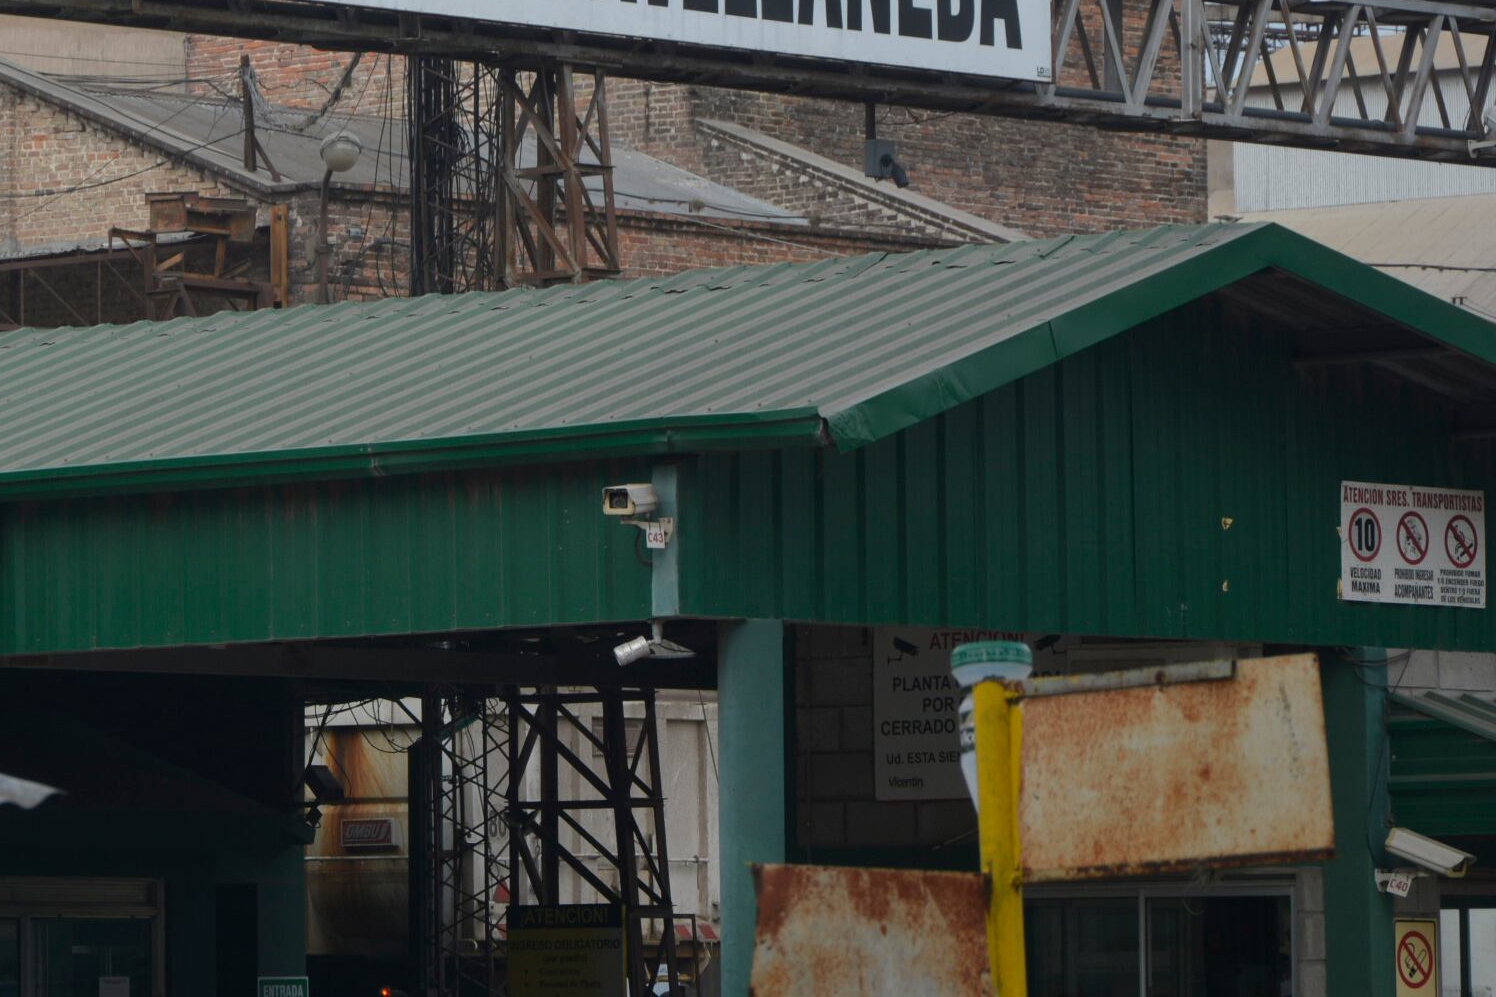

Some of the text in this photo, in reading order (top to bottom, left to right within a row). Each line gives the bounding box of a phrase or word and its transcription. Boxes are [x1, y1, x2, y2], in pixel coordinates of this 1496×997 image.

[1343, 487, 1483, 512] ATENCION SRES. TRANSPORTISTAS
[648, 532, 664, 544] C43
[1355, 518, 1375, 552] 10
[1350, 568, 1382, 580] VELOCIDAD
[1351, 582, 1381, 594] MAXIMA
[892, 675, 951, 692] PLANTA
[922, 697, 954, 713] POR
[880, 718, 956, 736] CERRADO
[886, 752, 904, 765] Ud.
[907, 751, 936, 764] ESTA
[888, 776, 924, 788] Vicentin
